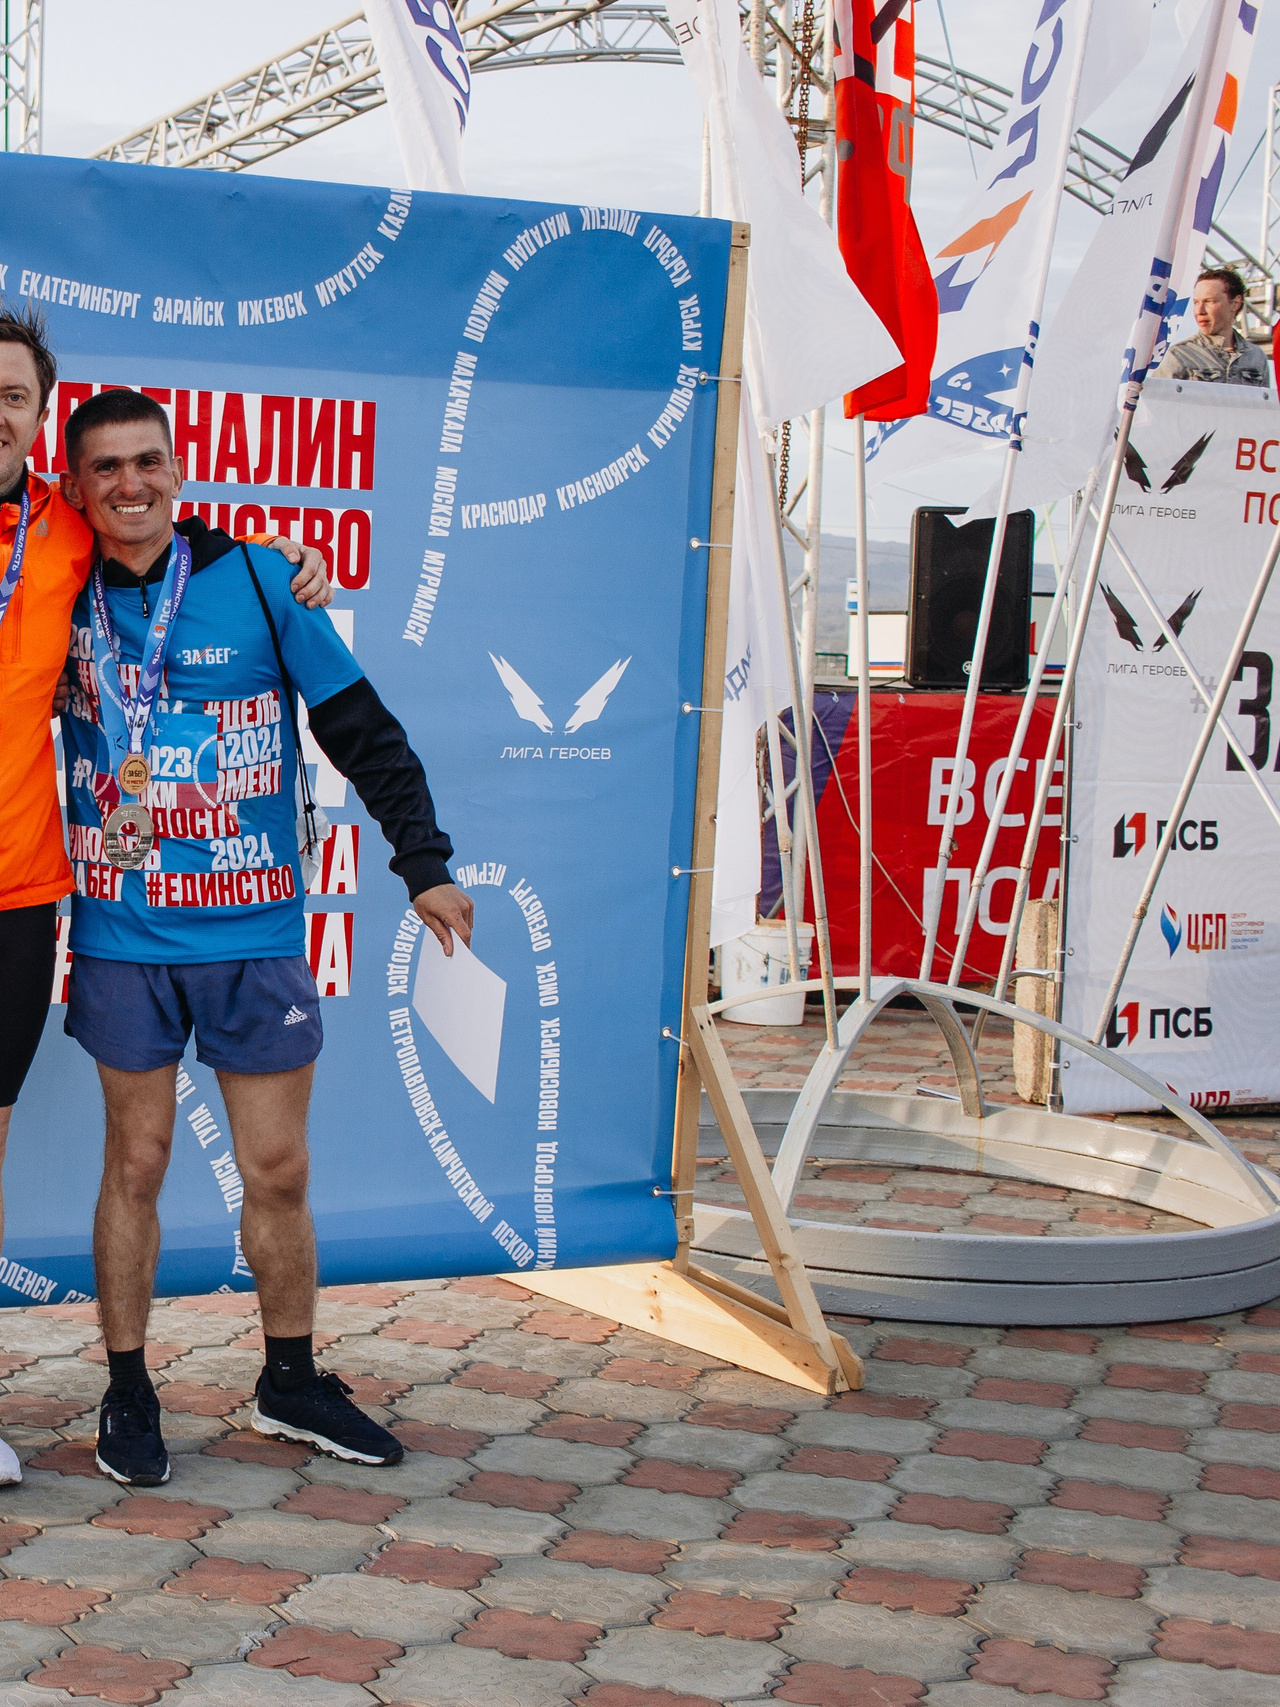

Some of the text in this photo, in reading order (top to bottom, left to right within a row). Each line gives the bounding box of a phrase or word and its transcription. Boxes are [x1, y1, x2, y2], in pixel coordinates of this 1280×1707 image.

[19, 269, 141, 319] ЕКАТЕРИНБУРГ
[153, 296, 224, 327] ЗАРАЙСК
[238, 290, 308, 326] ИЖЕВСК
[314, 242, 385, 308] ИРКУТСК
[402, 206, 702, 647] КРАСНОДАР КРАСНОЯРСК КУРИЛЬСК КУРСК КЫЗЫЛ ЛИПЕЦК МАГАДАН МАЙКОП МАХАЧКАЛА МОСКВА МУРМАНСК
[1112, 504, 1197, 519] ЛИГА ГЕРОЕВ
[12, 527, 25, 571] ОБЛАСТЬ
[1107, 664, 1138, 675] ЛИГА
[150, 745, 192, 778] 023
[225, 724, 282, 769] 2024
[500, 746, 611, 760] ЛИГА ГЕРОЕВ
[210, 832, 274, 873] 2024
[456, 862, 507, 888] ПЕРМЬ
[72, 861, 124, 902] АБЕГ
[146, 863, 296, 908] #ЕДИНСТВО
[508, 878, 552, 952] ОРЕНБУРГ
[386, 908, 424, 997] ОЗАВОДСК
[536, 961, 559, 1007] ОМСК
[1150, 1007, 1213, 1039] ПСБ
[538, 1017, 561, 1130] НОВОСИБИРСК
[187, 1103, 244, 1213] ТОМСК ТУЛА
[389, 1007, 535, 1268] ПЕТРОПАВЛОВСК-КАМЧАТСКИЙ ПСКОВ
[534, 1141, 558, 1224] НОВГОРОД
